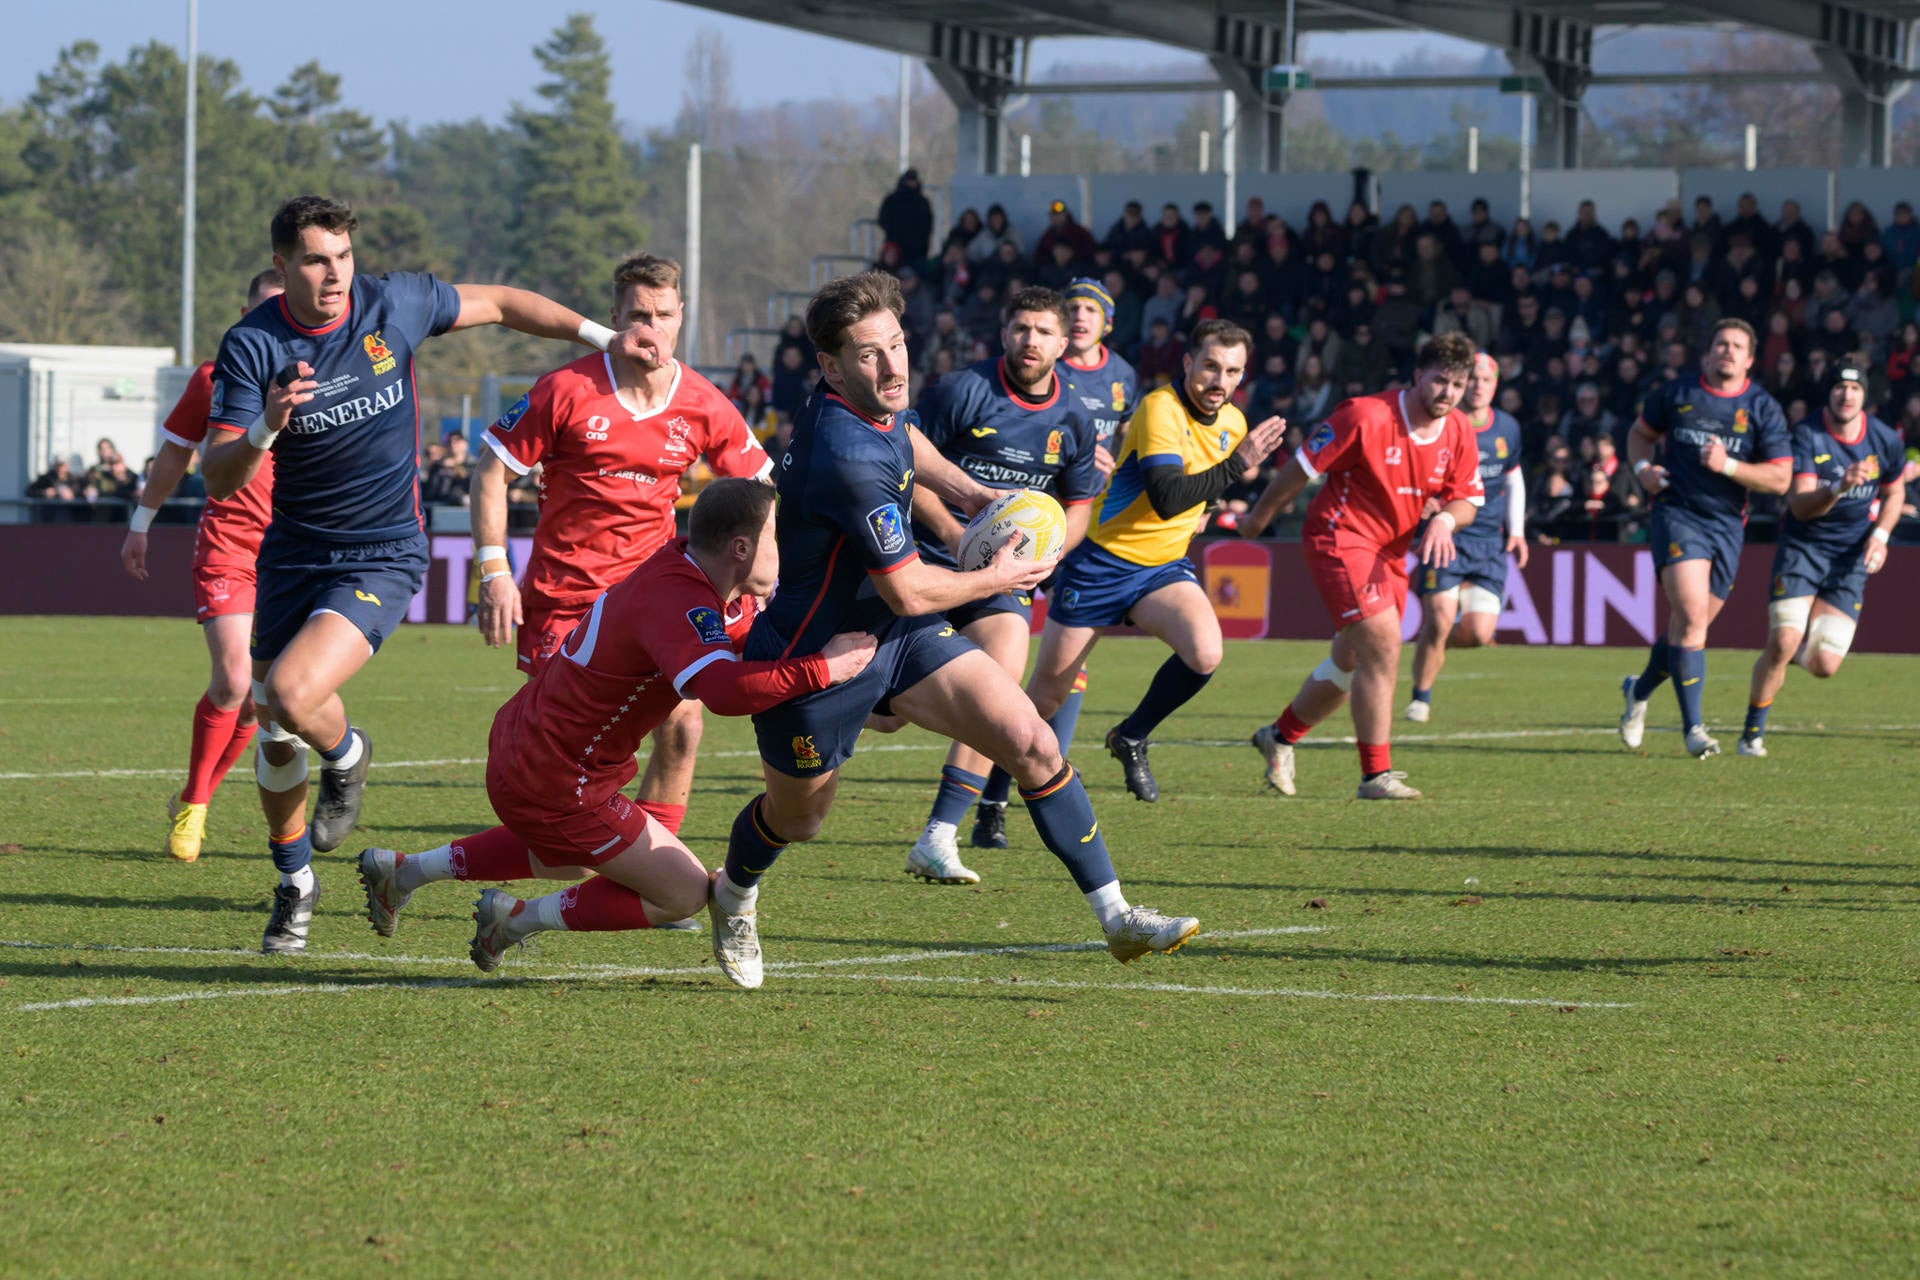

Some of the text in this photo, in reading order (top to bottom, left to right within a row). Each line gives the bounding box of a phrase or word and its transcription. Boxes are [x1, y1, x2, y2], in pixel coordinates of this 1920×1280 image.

[286, 379, 405, 434] GENERALI
[585, 431, 609, 441] one
[614, 470, 635, 480] ARE
[960, 456, 1054, 489] GENERALI
